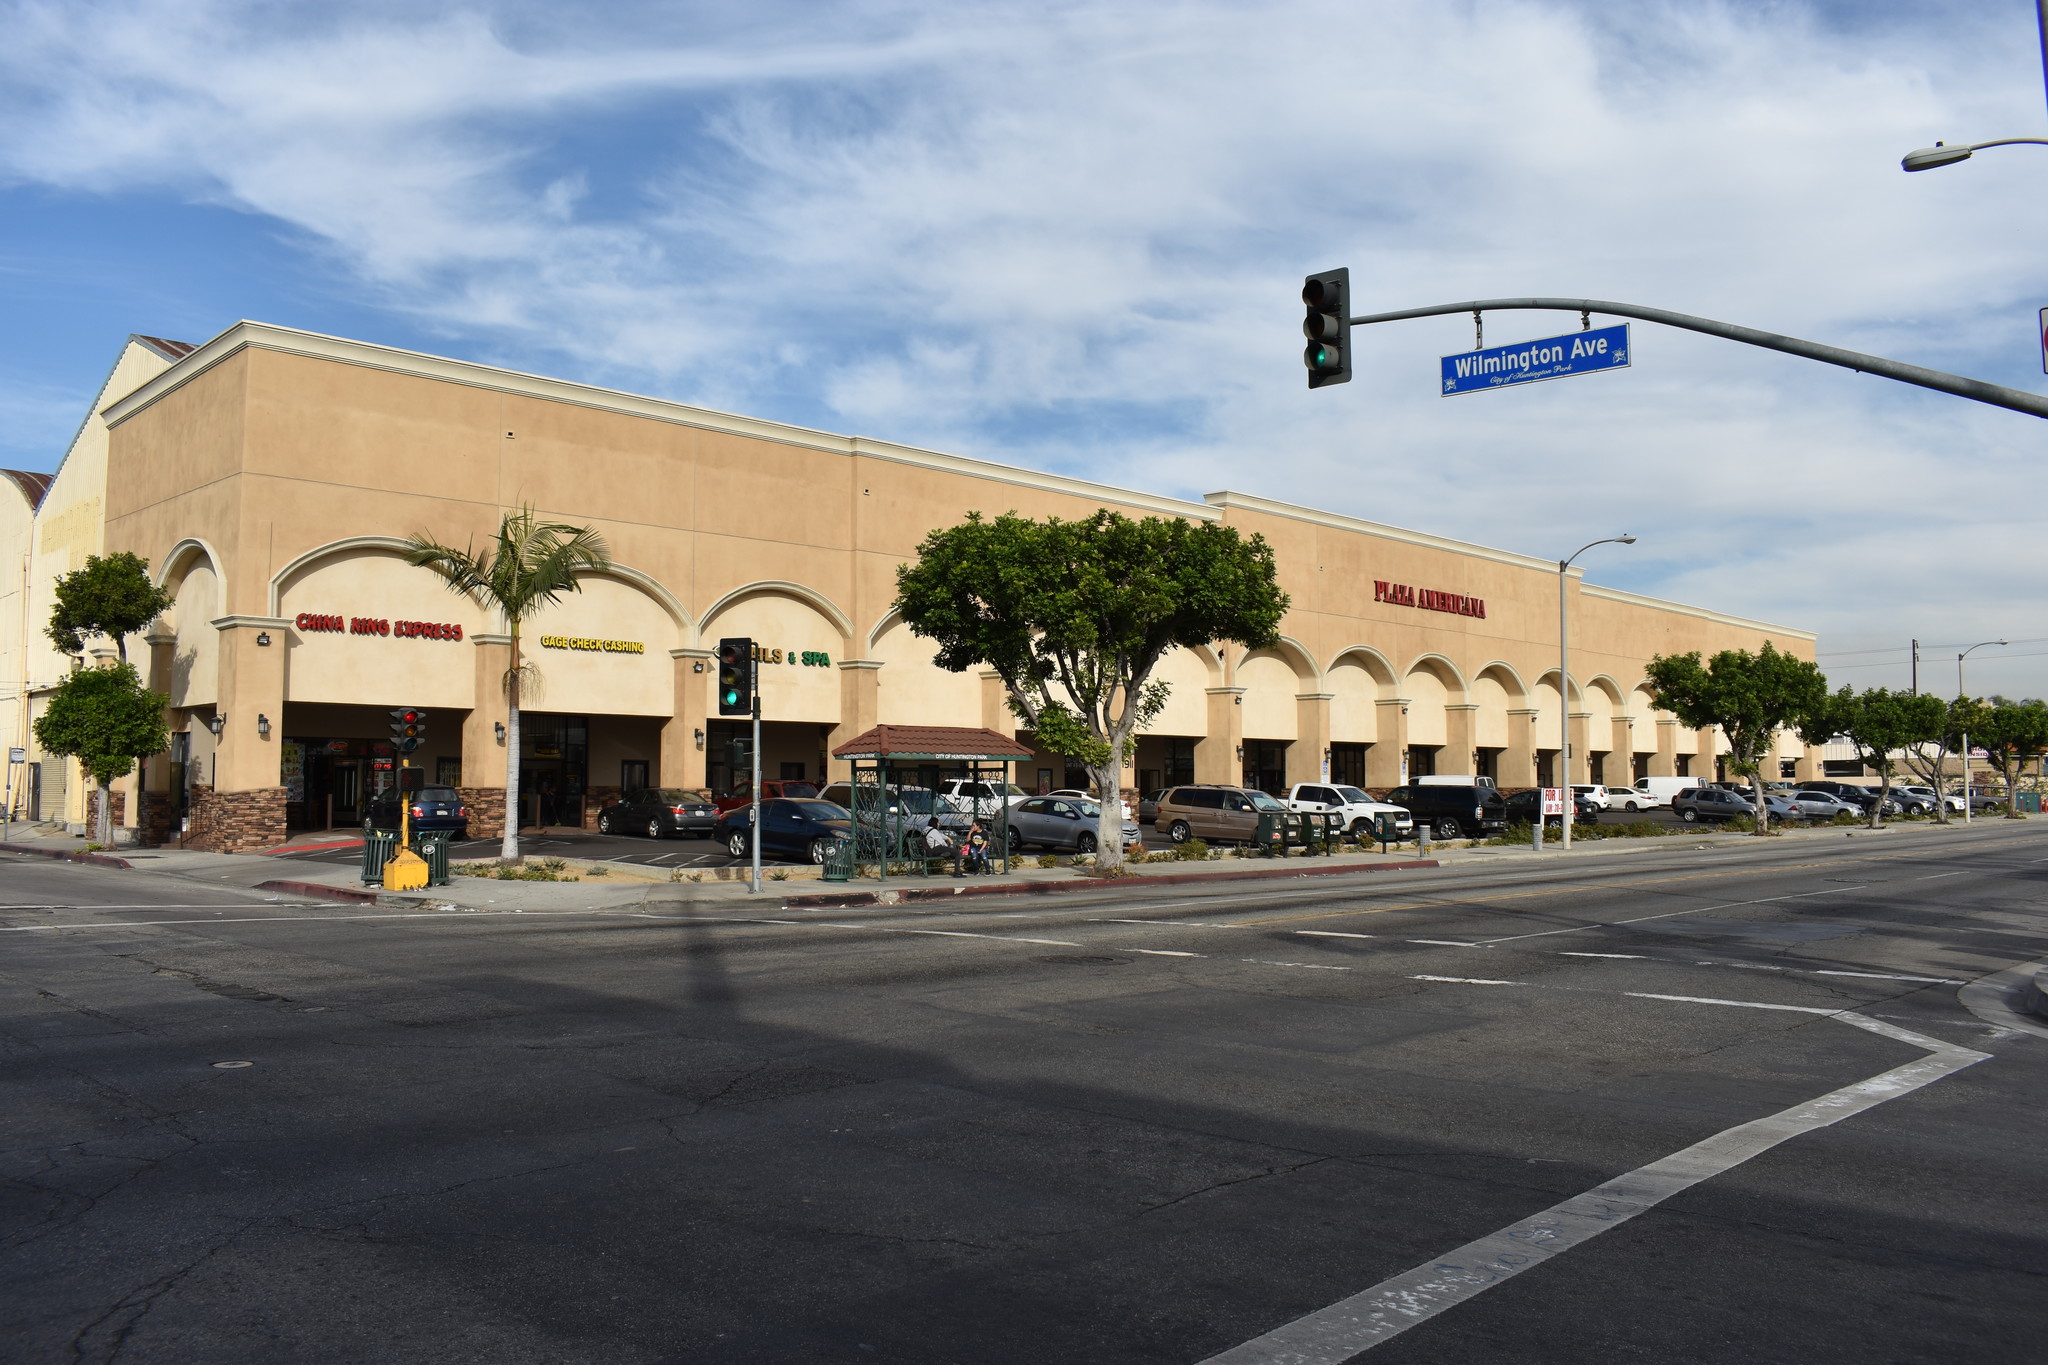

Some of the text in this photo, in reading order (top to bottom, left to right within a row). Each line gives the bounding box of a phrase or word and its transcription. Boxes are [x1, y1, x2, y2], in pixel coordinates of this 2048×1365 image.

[1455, 337, 1608, 378] Wilmington Ave
[1490, 364, 1573, 384] City of Huntington Park
[1374, 580, 1486, 619] PLAZA AMERICANA
[296, 613, 463, 641] CHINA KING EXPRESS
[541, 635, 645, 654] GAGE CHECK CASHING
[788, 651, 796, 665] &
[802, 651, 830, 667] SPA
[1545, 789, 1556, 801] FOR
